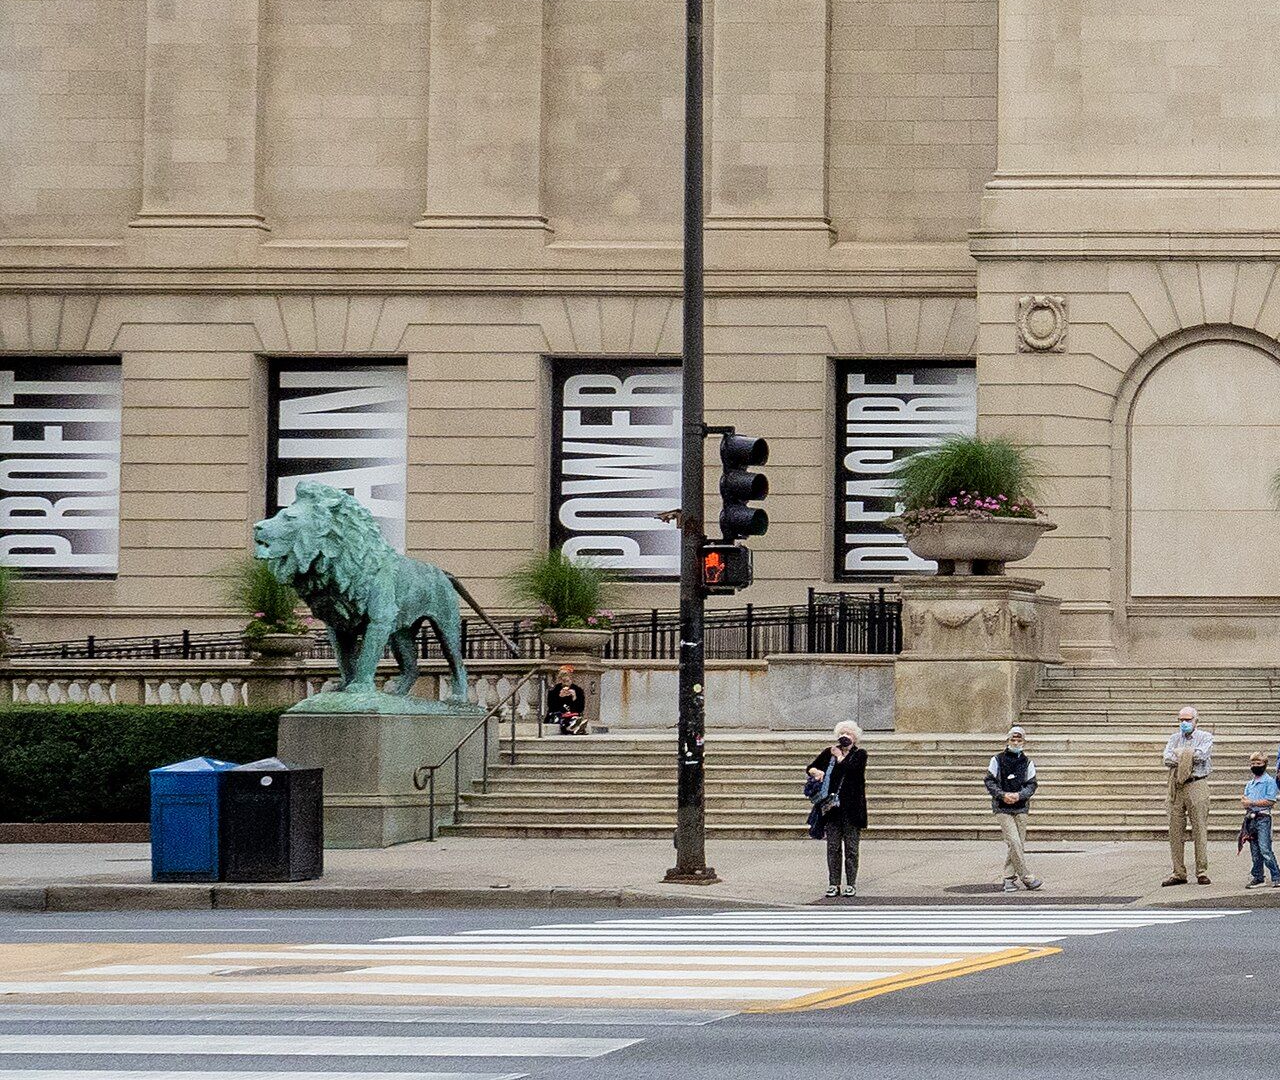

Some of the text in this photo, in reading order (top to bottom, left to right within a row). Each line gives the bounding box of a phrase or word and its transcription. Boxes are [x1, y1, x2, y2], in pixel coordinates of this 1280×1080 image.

[0, 370, 120, 568] PROFIT
[278, 370, 406, 522] AIN
[558, 373, 683, 576] POWER
